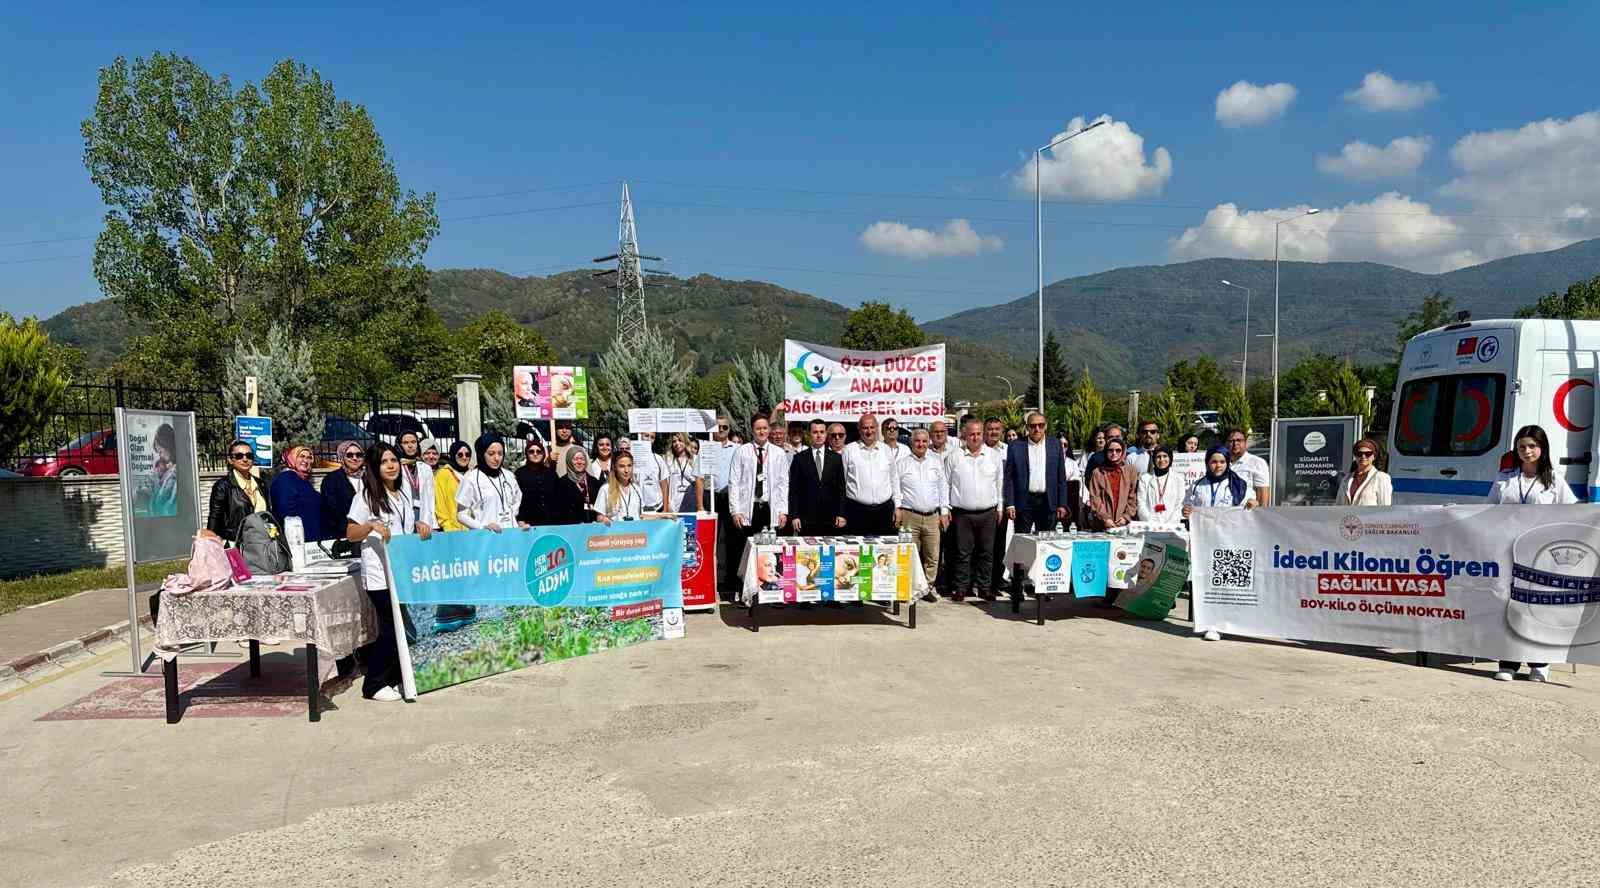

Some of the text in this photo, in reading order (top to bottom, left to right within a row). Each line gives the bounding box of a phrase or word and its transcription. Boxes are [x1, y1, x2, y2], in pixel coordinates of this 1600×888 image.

[884, 354, 937, 372] DÜZCE
[849, 377, 924, 394] ANADOLU
[839, 399, 897, 416] MESLEK
[130, 444, 145, 453] Olan
[131, 453, 154, 461] Normal
[411, 553, 520, 584] SAĞLIĞIN İÇİN
[1273, 545, 1500, 580] İdeal Kilonu Öğren
[1319, 574, 1443, 595] SAĞLIKLI YAŞA
[1300, 597, 1466, 620] BOY-KİLO ÖLÇÜM NOKTASI
